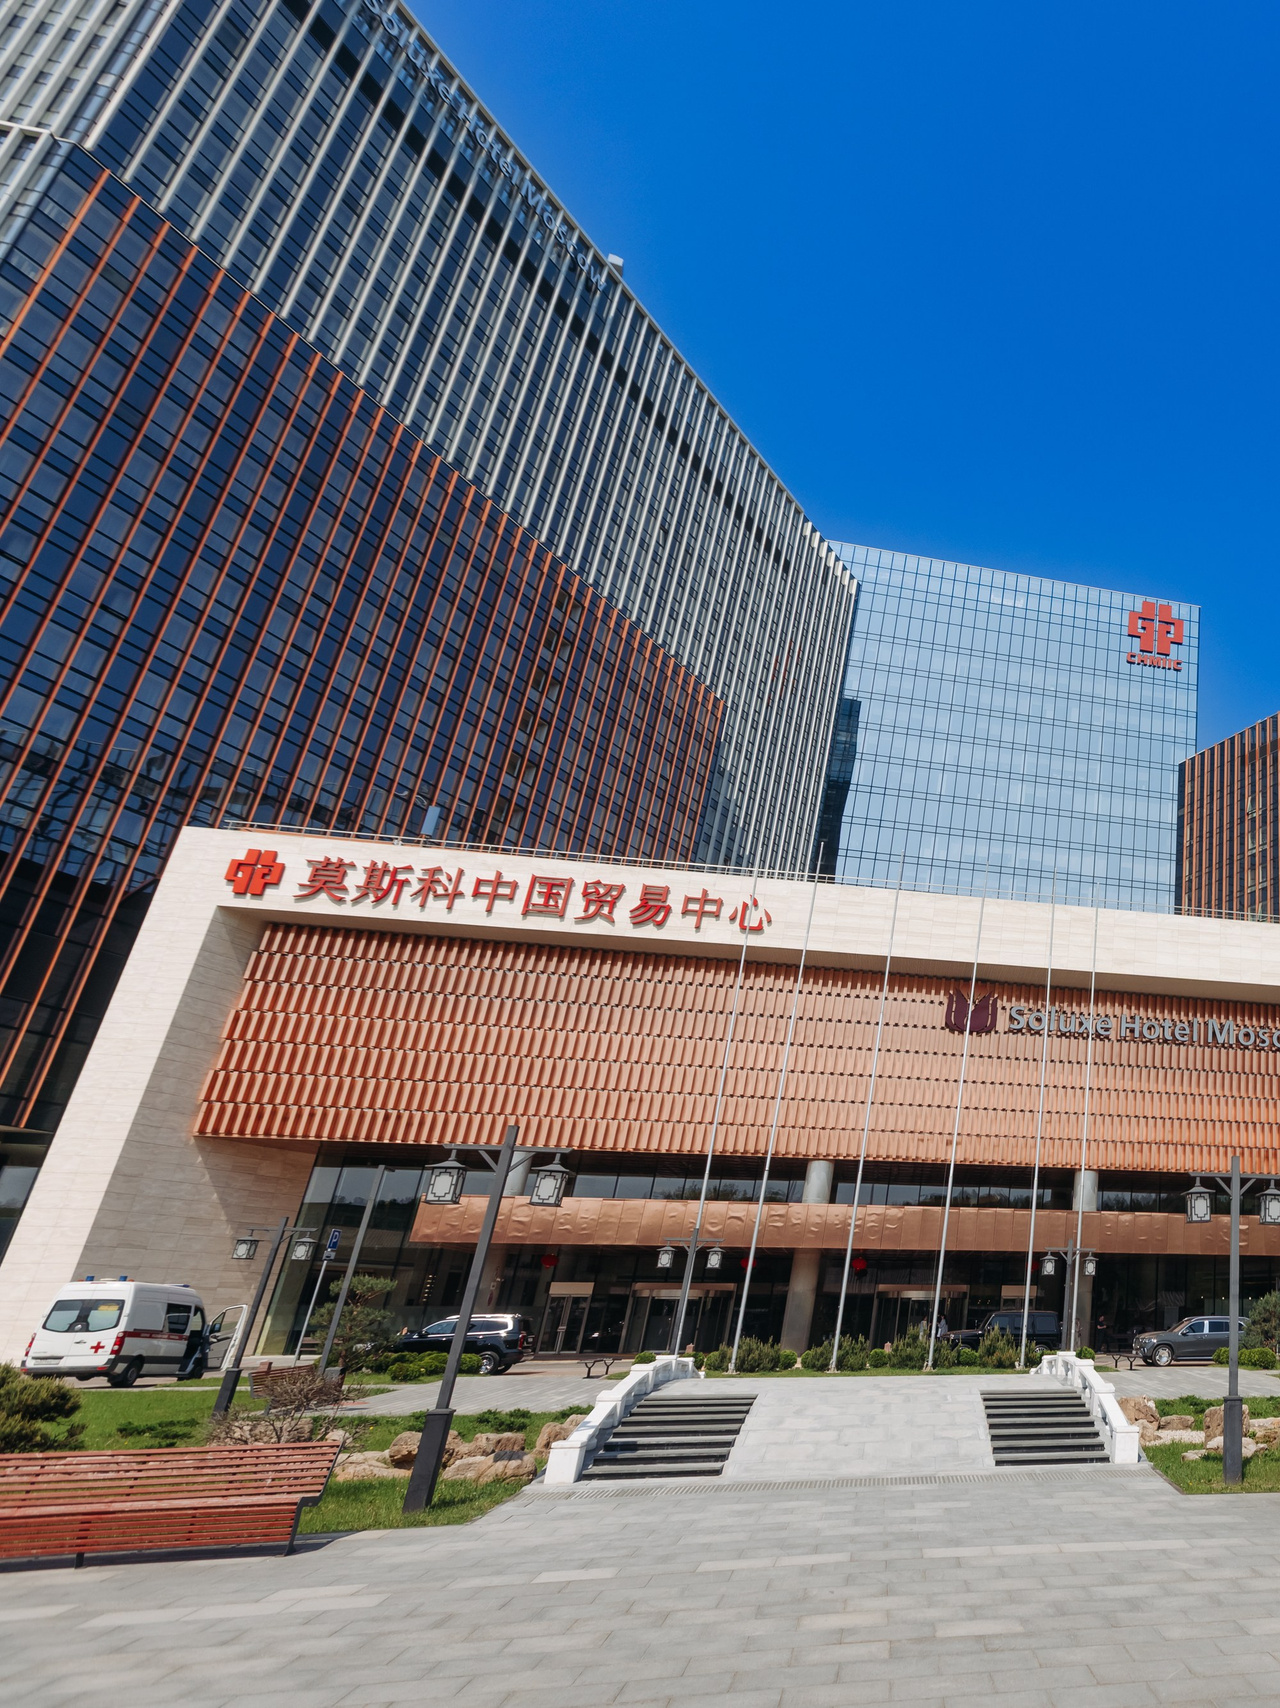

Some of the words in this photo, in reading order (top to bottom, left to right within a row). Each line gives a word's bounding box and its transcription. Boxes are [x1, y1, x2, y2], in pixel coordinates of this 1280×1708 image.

[293, 855, 772, 932] 莫斯科中国贸易中心
[1009, 1006, 1113, 1036] Soluxe
[1120, 1013, 1199, 1042] Hotel
[330, 1231, 339, 1247] P
